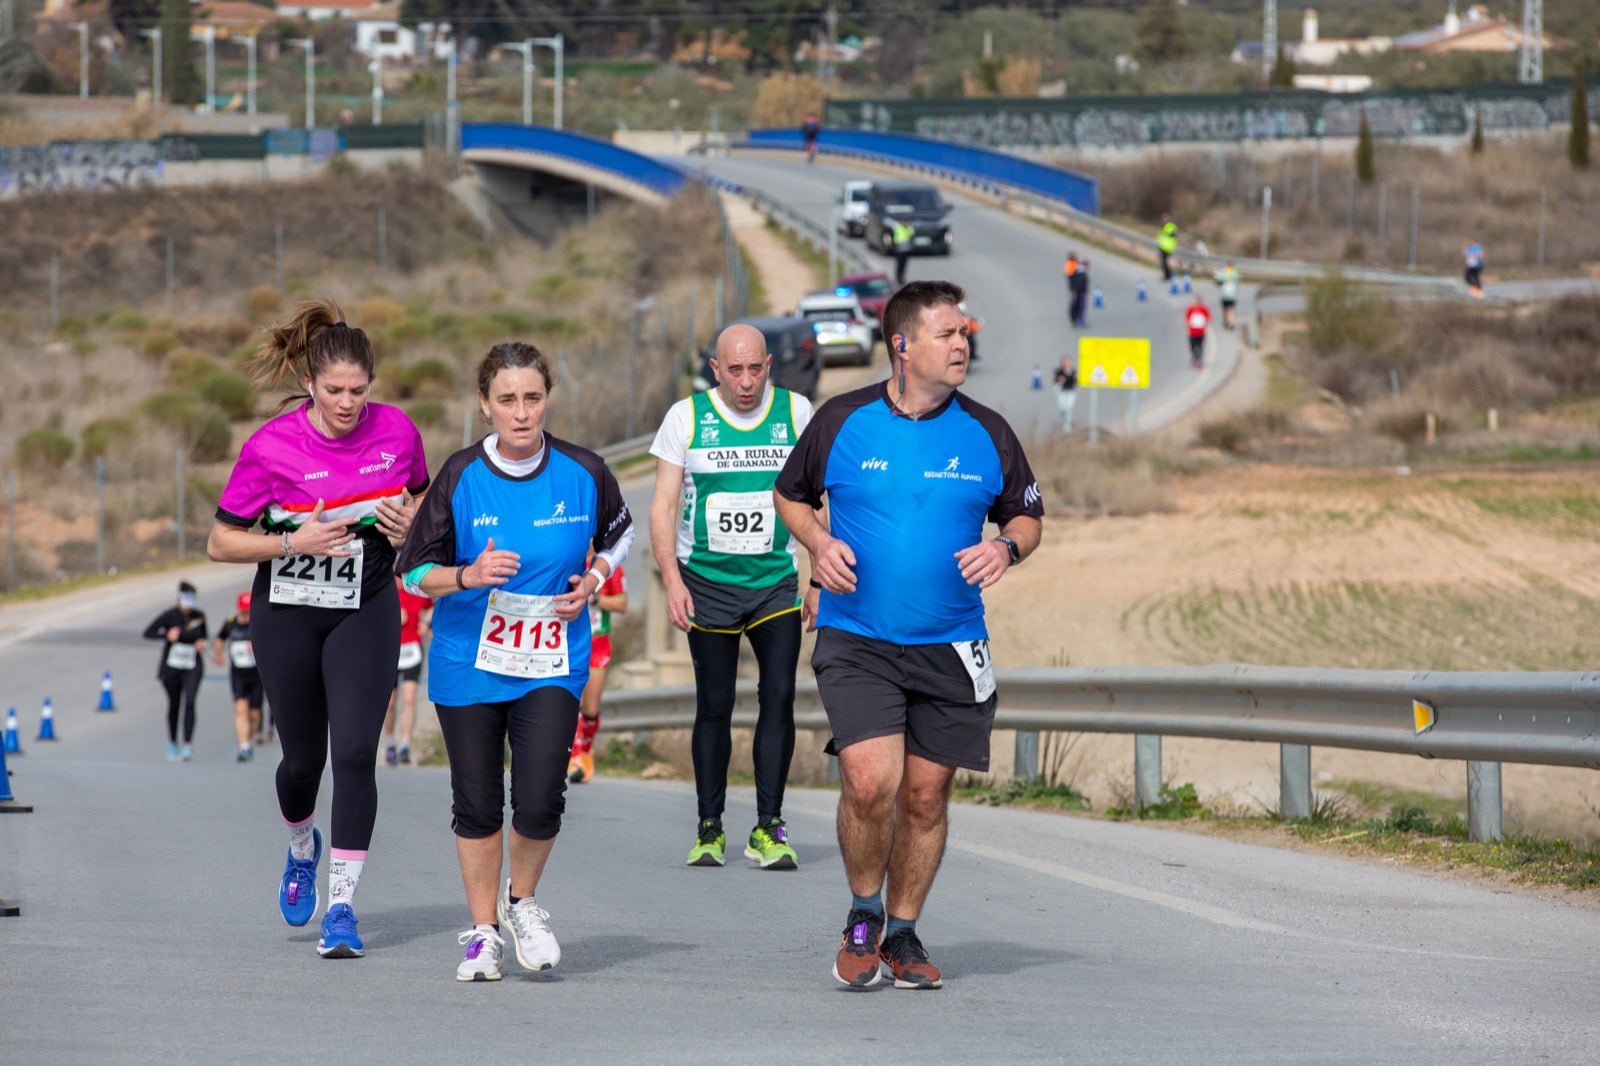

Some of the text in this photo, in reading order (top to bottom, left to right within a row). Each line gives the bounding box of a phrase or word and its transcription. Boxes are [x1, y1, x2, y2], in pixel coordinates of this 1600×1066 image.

[707, 449, 787, 461] CAJA RURAL
[717, 459, 779, 469] DE GRANADA
[304, 470, 329, 481] FASTER
[718, 511, 764, 534] 592
[277, 554, 357, 583] 2214
[486, 614, 562, 650] 2113
